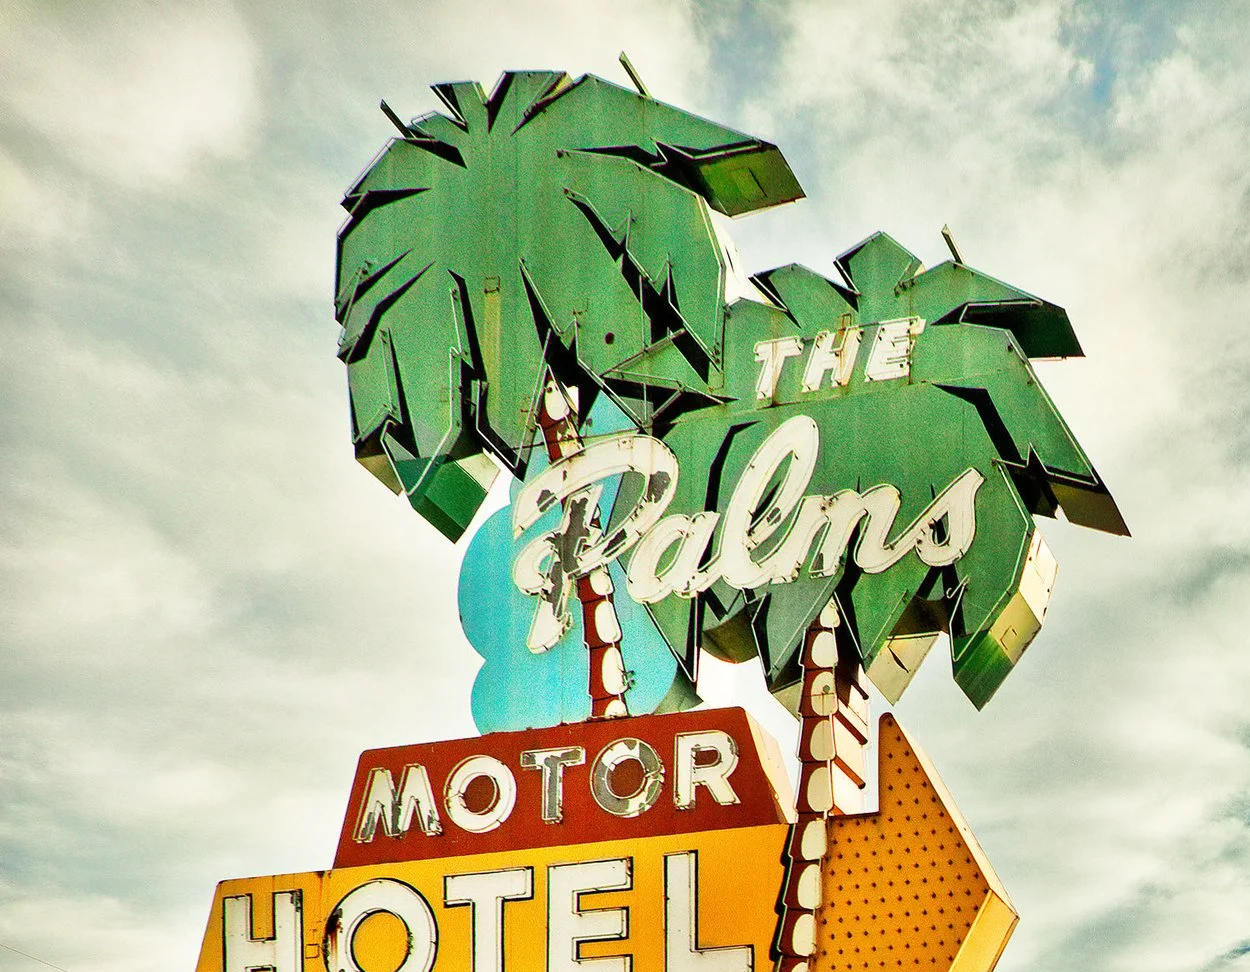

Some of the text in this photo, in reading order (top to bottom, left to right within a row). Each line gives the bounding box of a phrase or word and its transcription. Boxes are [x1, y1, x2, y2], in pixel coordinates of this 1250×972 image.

[754, 316, 925, 406] THE
[512, 415, 986, 654] Palms
[352, 730, 741, 843] MOTOR
